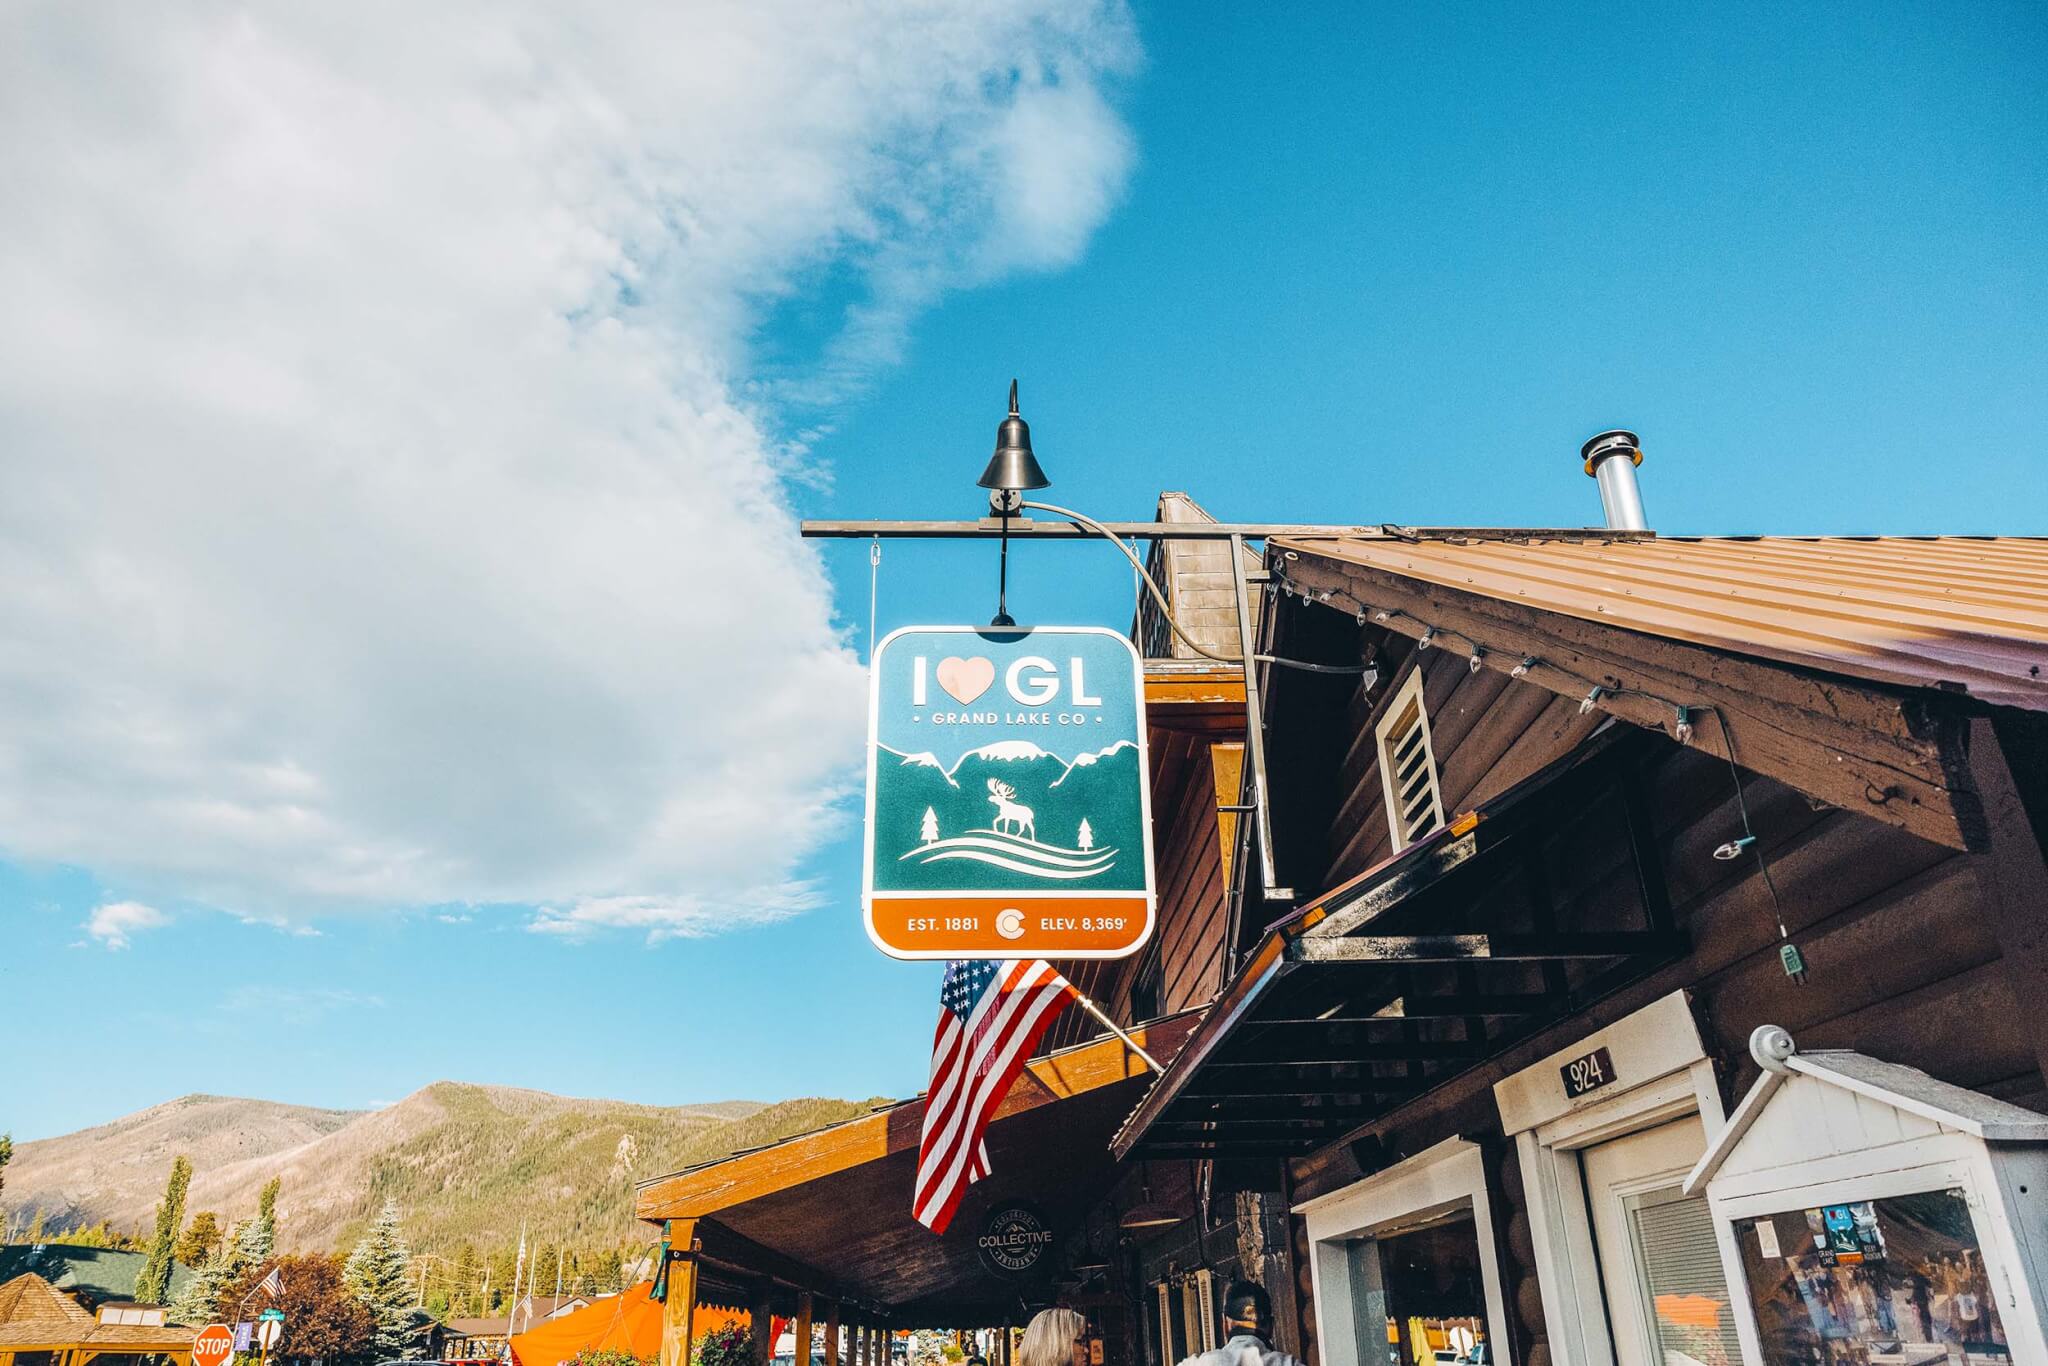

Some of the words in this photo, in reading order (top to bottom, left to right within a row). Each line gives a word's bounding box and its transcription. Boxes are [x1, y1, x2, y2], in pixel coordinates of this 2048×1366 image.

[913, 656, 926, 706] I
[1005, 655, 1102, 707] GL
[932, 712, 998, 725] GRAND
[1006, 712, 1050, 725] LAKE
[1058, 712, 1085, 726] CO
[907, 918, 940, 931] EST.
[945, 917, 979, 931] 1881
[1040, 917, 1078, 930] ELEV.
[1570, 1054, 1603, 1093] 924
[978, 1231, 1053, 1248] COLLECTIVE
[195, 1338, 231, 1355] STOP
